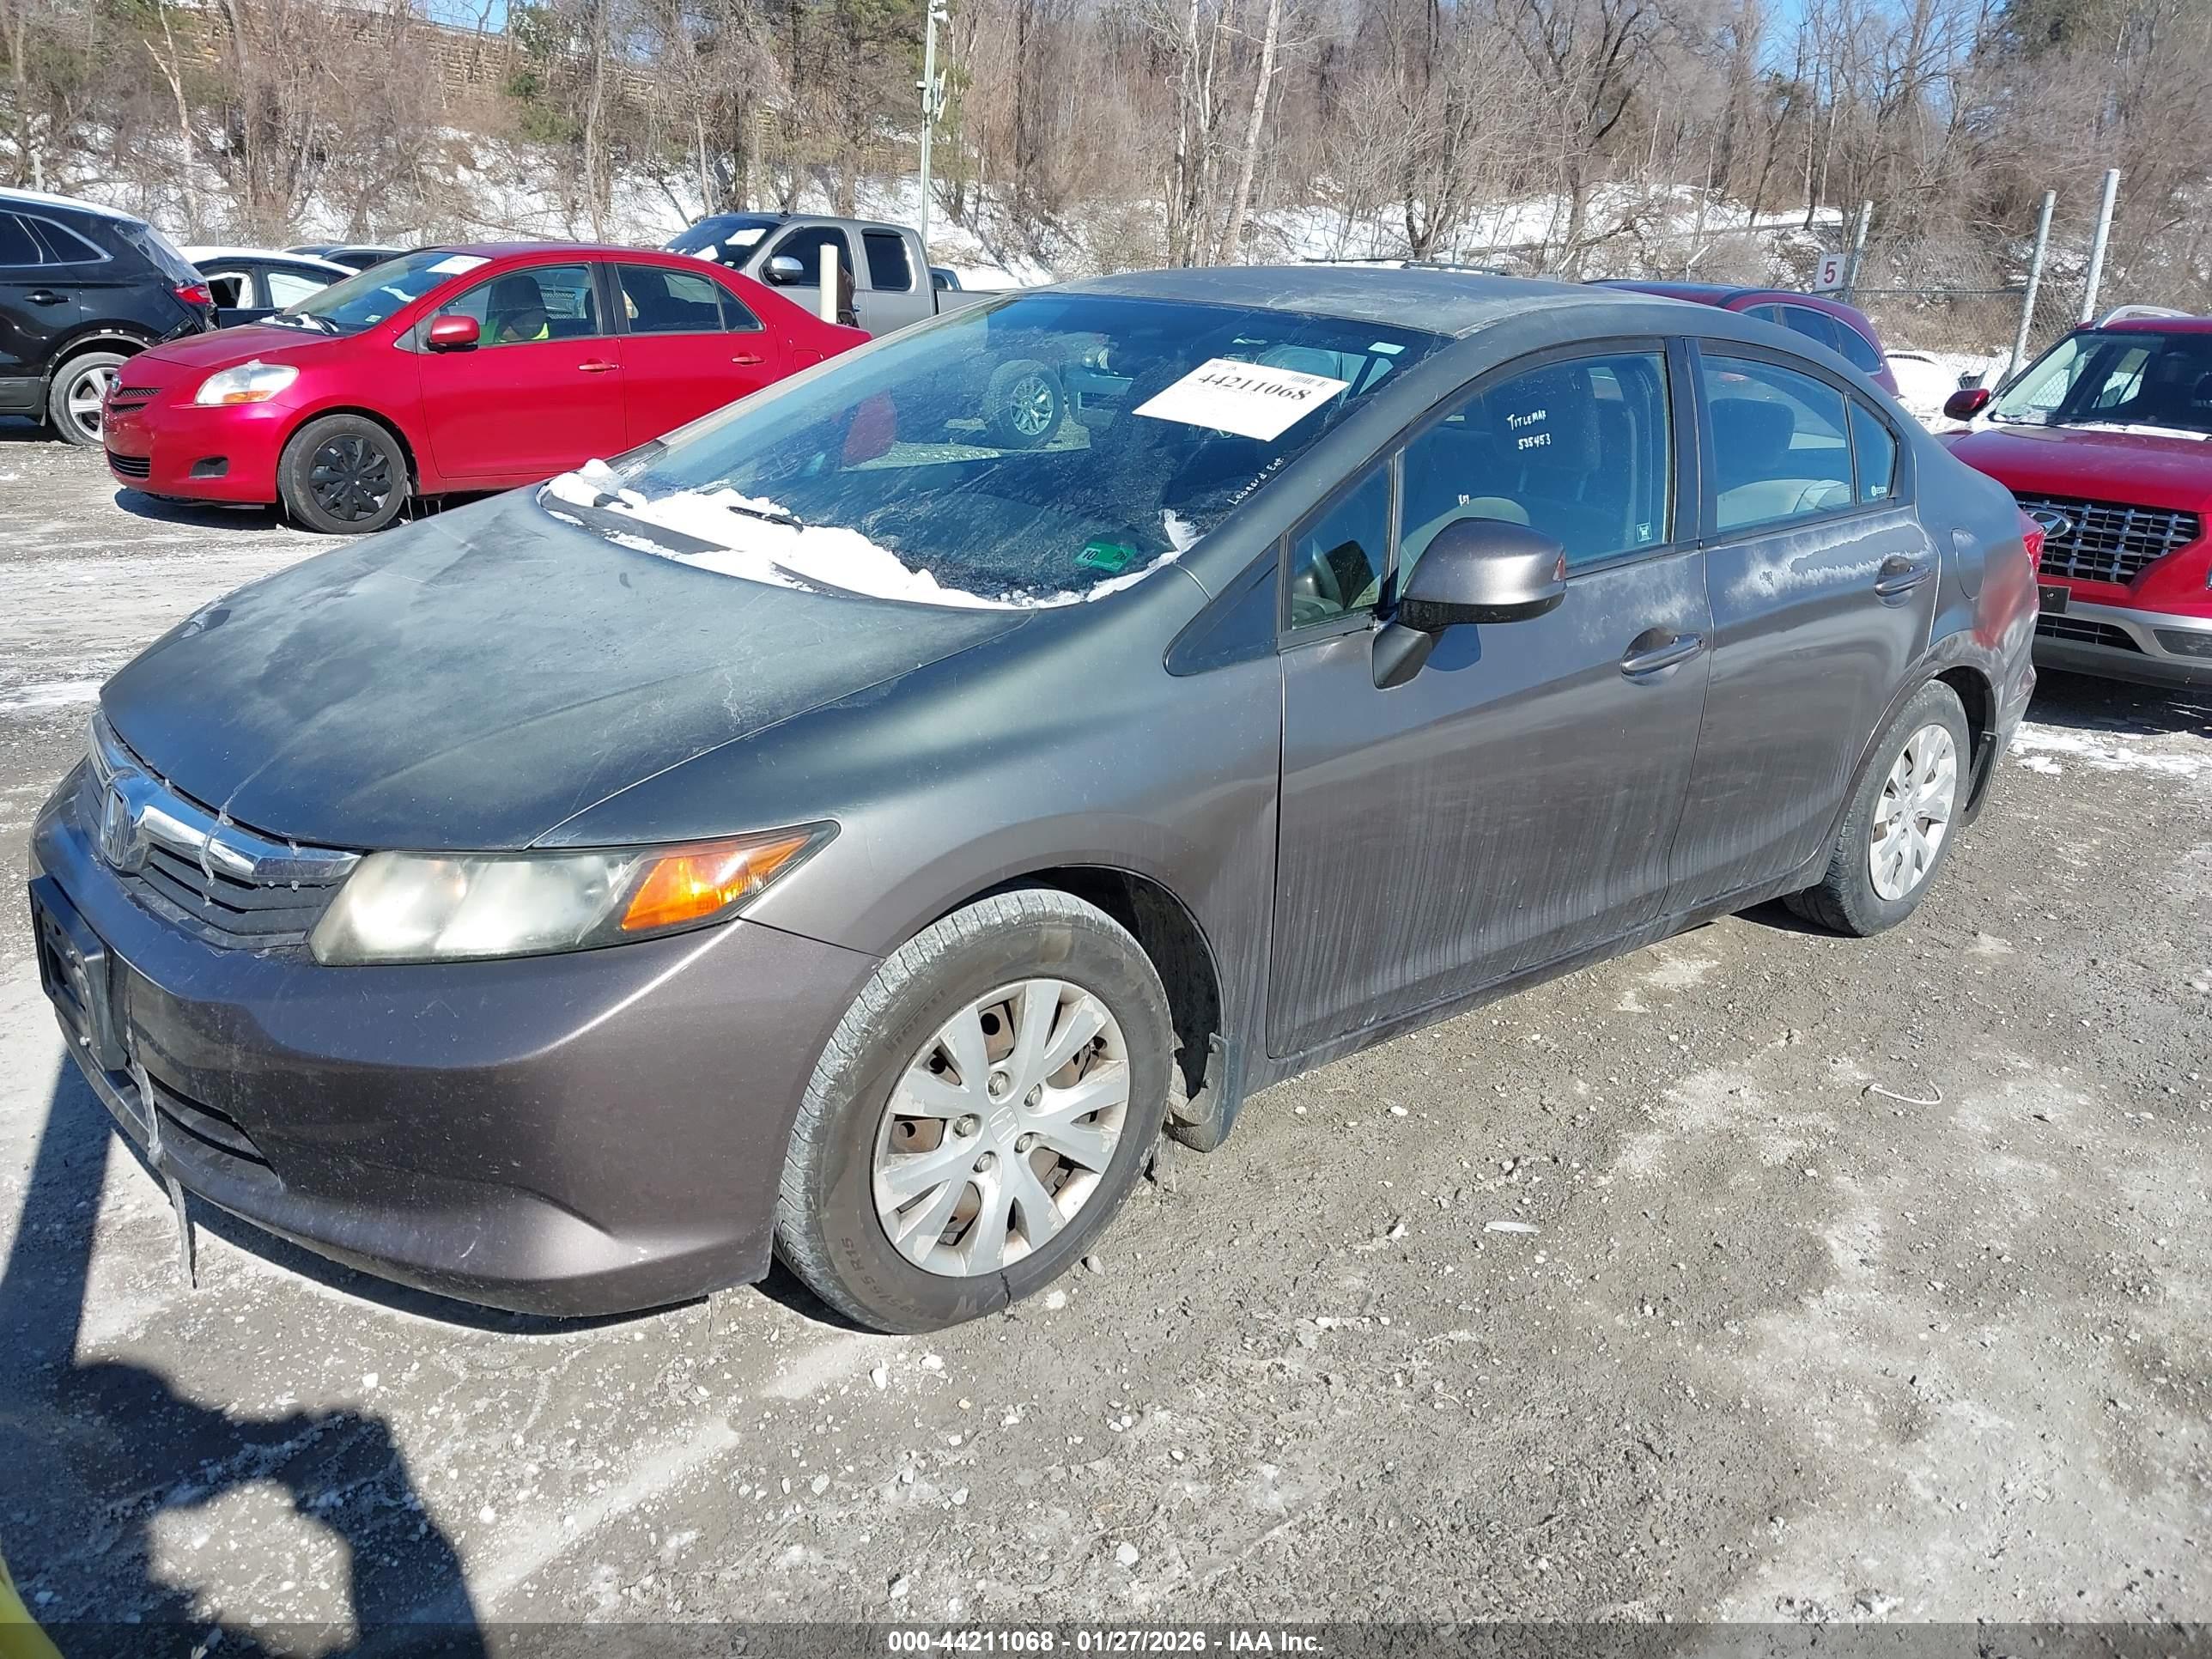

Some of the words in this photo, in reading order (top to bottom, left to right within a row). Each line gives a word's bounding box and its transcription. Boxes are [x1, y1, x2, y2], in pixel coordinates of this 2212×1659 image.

[1824, 261, 1838, 284] 5
[1197, 373, 1312, 401] 44211068
[1518, 433, 1551, 450] 535453
[1082, 550, 1098, 561] 10
